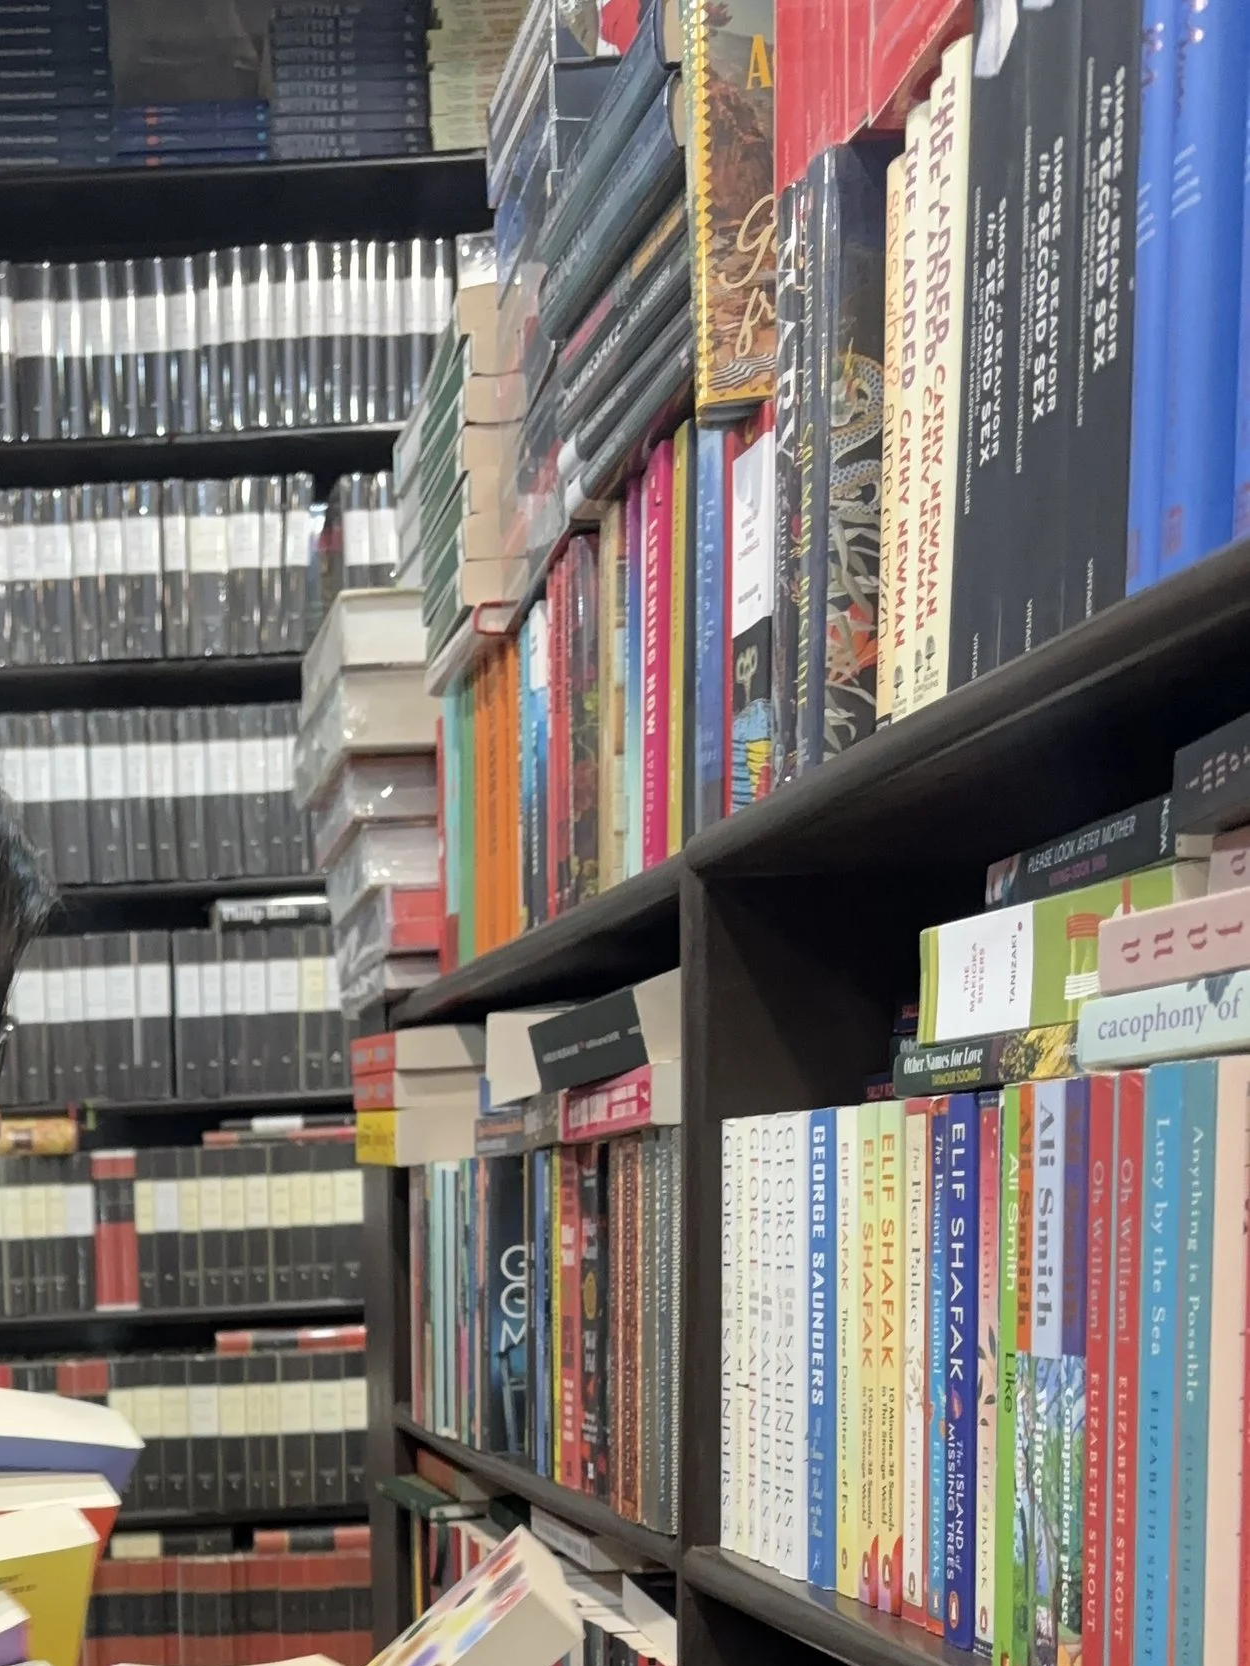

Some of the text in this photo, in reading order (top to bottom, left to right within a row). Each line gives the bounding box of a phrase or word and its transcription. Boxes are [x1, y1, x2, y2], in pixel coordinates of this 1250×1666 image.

[884, 282, 902, 388] who?
[979, 211, 998, 468] the SECOND SEX
[991, 198, 1007, 458] SIMONE BEAUVOIR
[1032, 152, 1051, 424] the SECOND SEX
[1047, 136, 1064, 414] SIMONE BEAUVOIR
[1092, 84, 1112, 374] the SECOND SEX
[1107, 65, 1126, 363] SIMONE BEAUVOIR
[880, 402, 896, 498] anne
[894, 136, 920, 650] THE LADDER CATHY NEWMAN
[925, 173, 953, 618] LADDER CATHY NEWMAN
[644, 518, 661, 738] LISTENING NOW
[797, 423, 814, 709] SALMAN RUSHDIE
[915, 498, 930, 632] NEWMAN
[1008, 934, 1017, 1004] TANIZAKI
[1028, 815, 1137, 874] PLEASE LOOK AFTER MOTHER
[903, 1046, 985, 1076] Other Names Love
[969, 942, 979, 1014] MAKIOKA
[1098, 986, 1245, 1042] cacophony of
[781, 1125, 796, 1520] GEORGE SAUNDERS
[810, 1124, 827, 1408] GEORGE SAUNDERS
[838, 1140, 850, 1460] ELIF SHAFAK Daughters
[860, 1138, 875, 1370] ELIF SHAFAK
[879, 1132, 896, 1370] ELIF SHAFAK
[948, 1120, 967, 1383] ELIF SHAFAK
[1004, 1156, 1020, 1415] Ali Smith Like
[1036, 1102, 1056, 1329] Ali Smith
[1148, 1116, 1171, 1554] Lucy by the Sea ELIZABETH
[1185, 1123, 1204, 1405] Anything Possible
[945, 1420, 958, 1583] MISSING TREES
[954, 1461, 966, 1550] ISLAND
[1085, 1159, 1104, 1634] Oh William! ELIZABETH STROUT
[1113, 1157, 1134, 1642] Oh William! ELIZABETH STROUT
